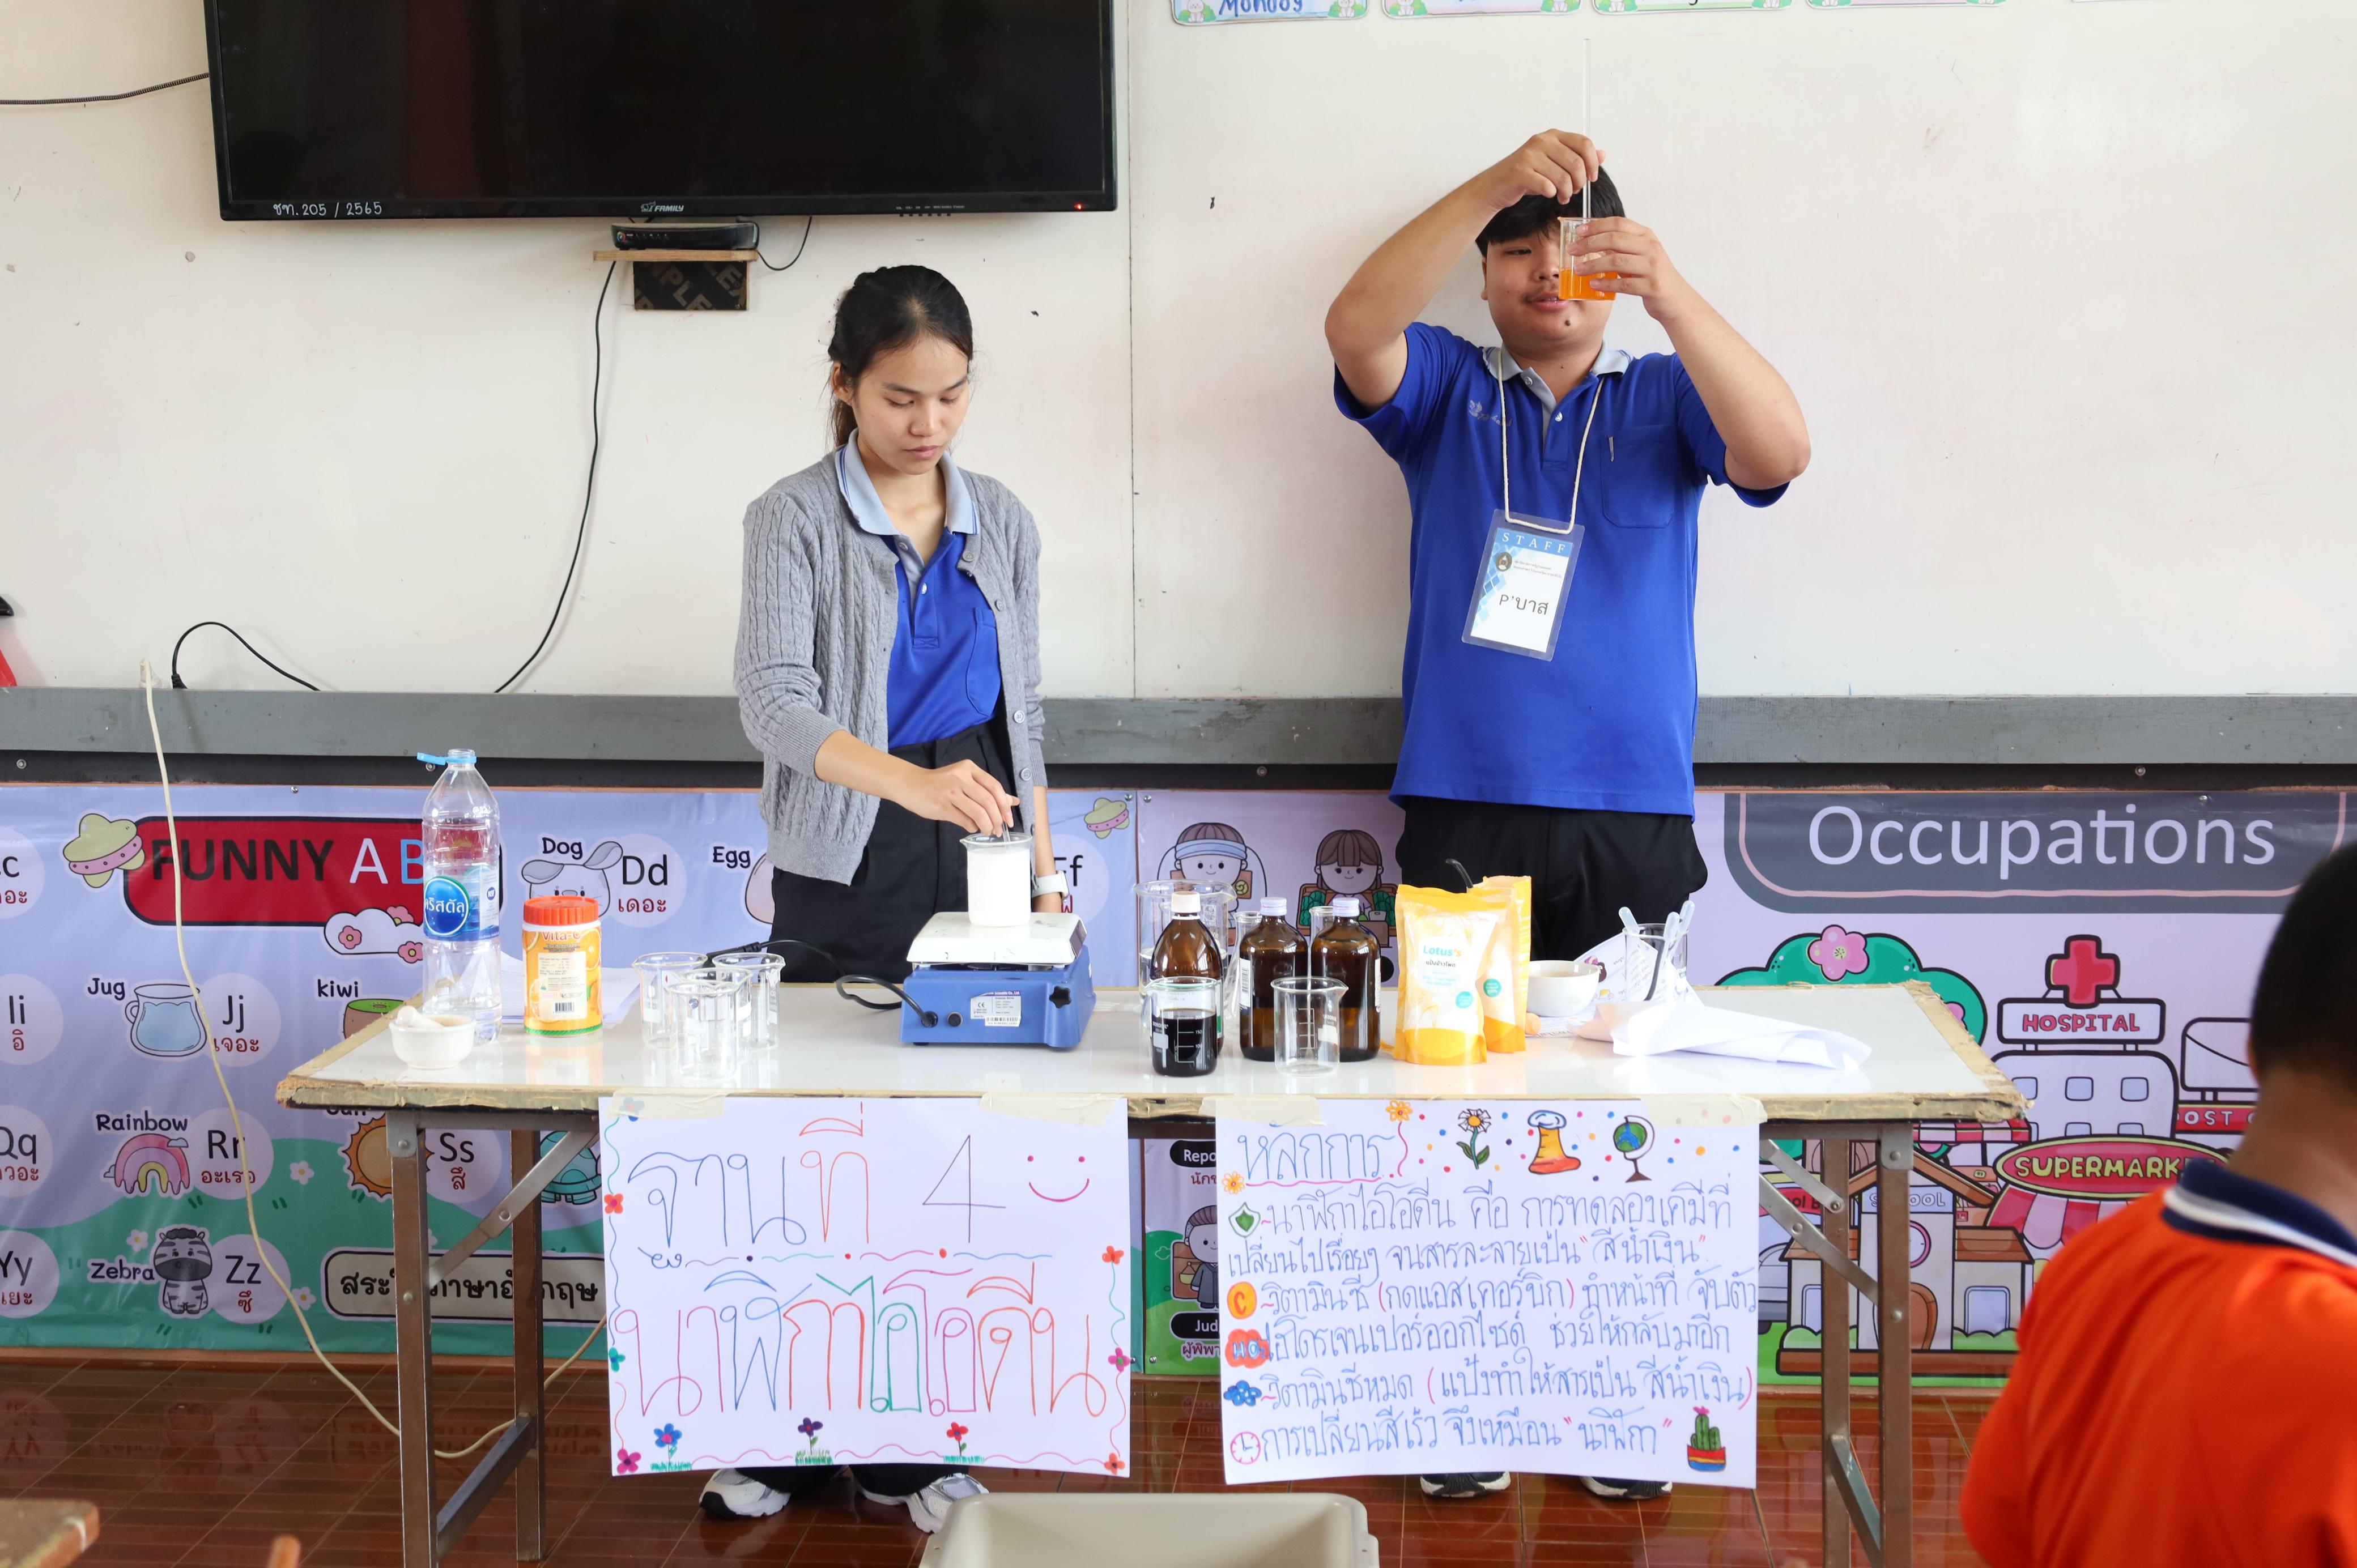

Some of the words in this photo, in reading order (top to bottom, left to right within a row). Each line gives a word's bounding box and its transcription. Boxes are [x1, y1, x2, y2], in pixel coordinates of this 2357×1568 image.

[302, 203, 327, 216] 205
[334, 202, 339, 218] /
[346, 202, 382, 215] 2565
[1501, 532, 1565, 553] STAFF
[542, 838, 583, 860] Dog
[1808, 804, 2276, 880] Occupations
[0, 856, 20, 878] c
[152, 838, 334, 881] FUNNY
[712, 847, 751, 869] Egg
[622, 854, 668, 887] Dd
[0, 890, 27, 904] อะ
[618, 898, 667, 914] เดอะ
[1423, 945, 1462, 957] Lotus's
[88, 978, 126, 1001] Jug
[317, 978, 359, 998] kiwi
[222, 995, 245, 1033] Jj
[2022, 1013, 2141, 1033] HOSPITAL
[96, 1111, 188, 1132] Rainbow
[2177, 1110, 2233, 1126] OST
[207, 1130, 245, 1159] Rr
[439, 1132, 475, 1163] Ss
[1184, 1149, 1216, 1165] Repo
[2014, 1156, 2190, 1179] SUPERMARK
[0, 1166, 39, 1181] วอะ
[922, 1134, 1006, 1243] 4
[1869, 1192, 1946, 1207] SOOL
[0, 1251, 33, 1286] Yy
[91, 1260, 155, 1281] Zebra
[226, 1255, 262, 1285] Zz
[1195, 1319, 1218, 1332] Jud
[1182, 1341, 1220, 1358] ผู้พิพา
